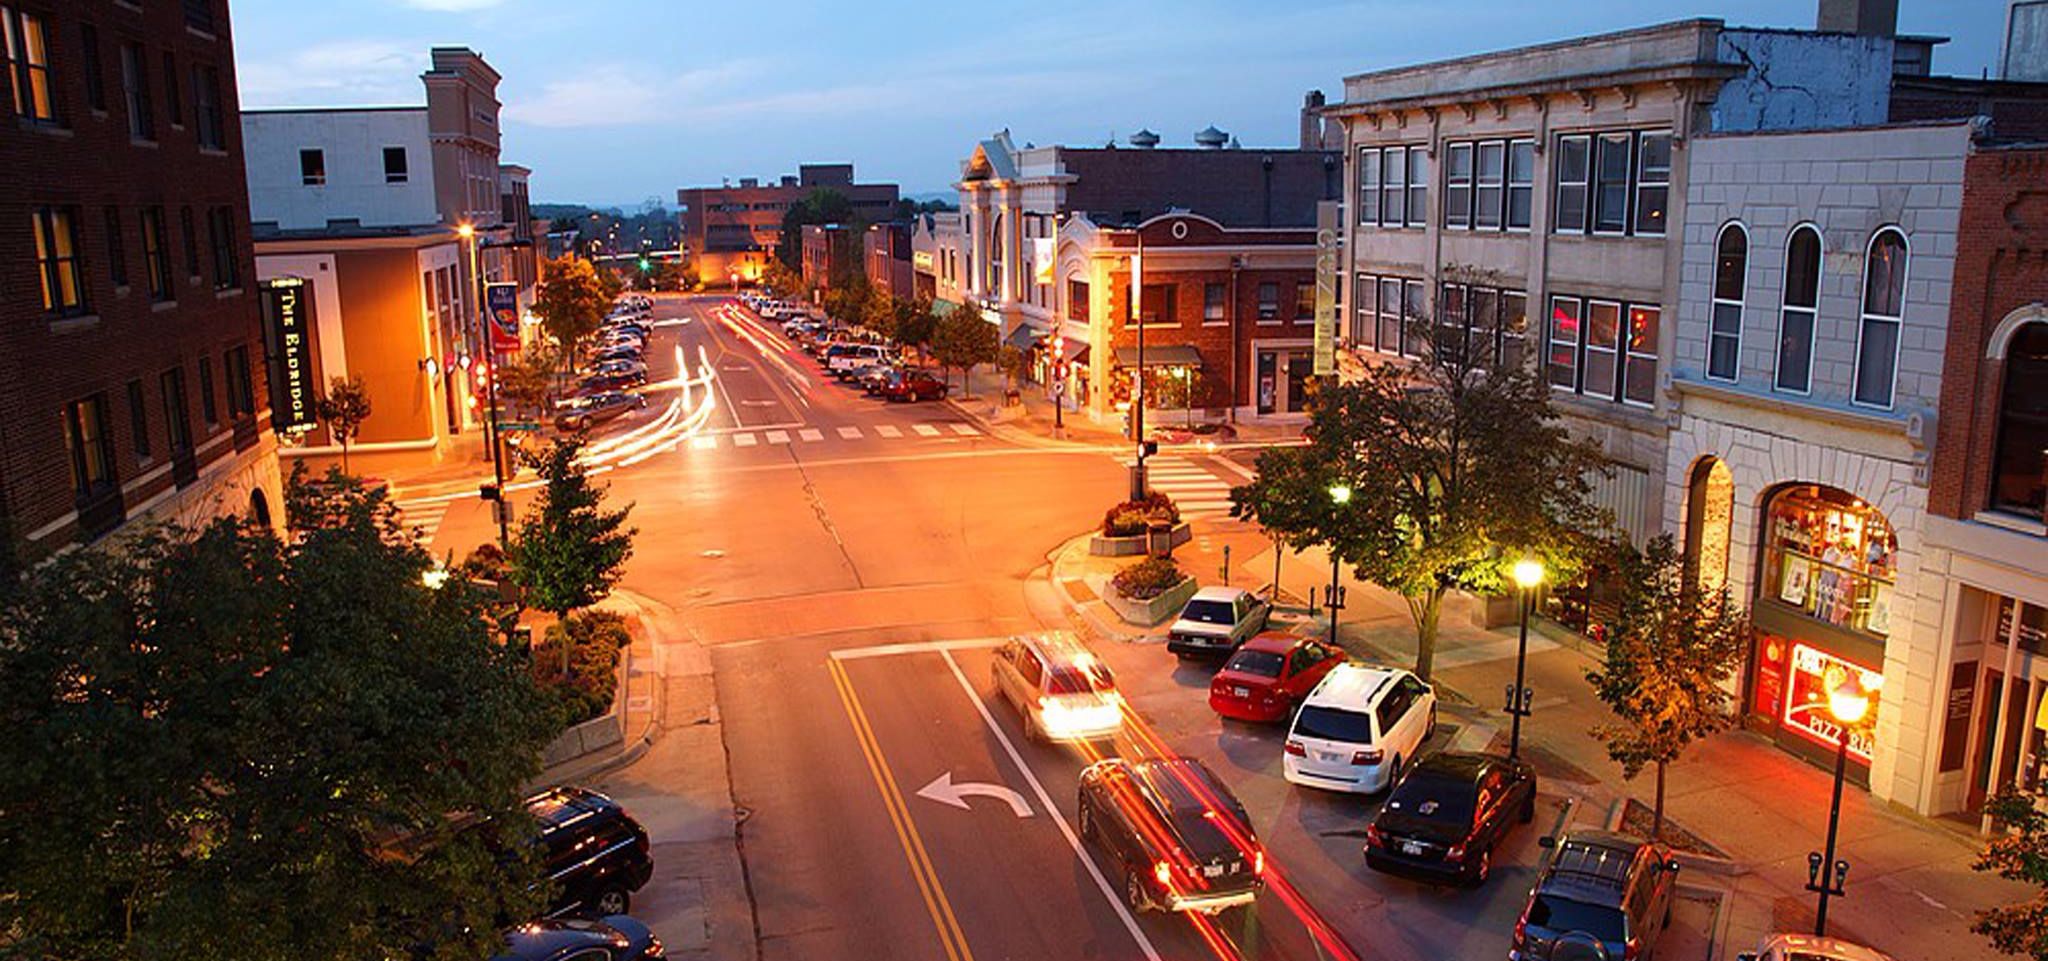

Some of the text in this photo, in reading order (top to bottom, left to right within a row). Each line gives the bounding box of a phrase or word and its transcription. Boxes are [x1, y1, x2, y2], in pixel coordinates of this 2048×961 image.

[281, 289, 304, 422] THE ELDRIDGE
[1810, 714, 1873, 755] PIZZRIA
